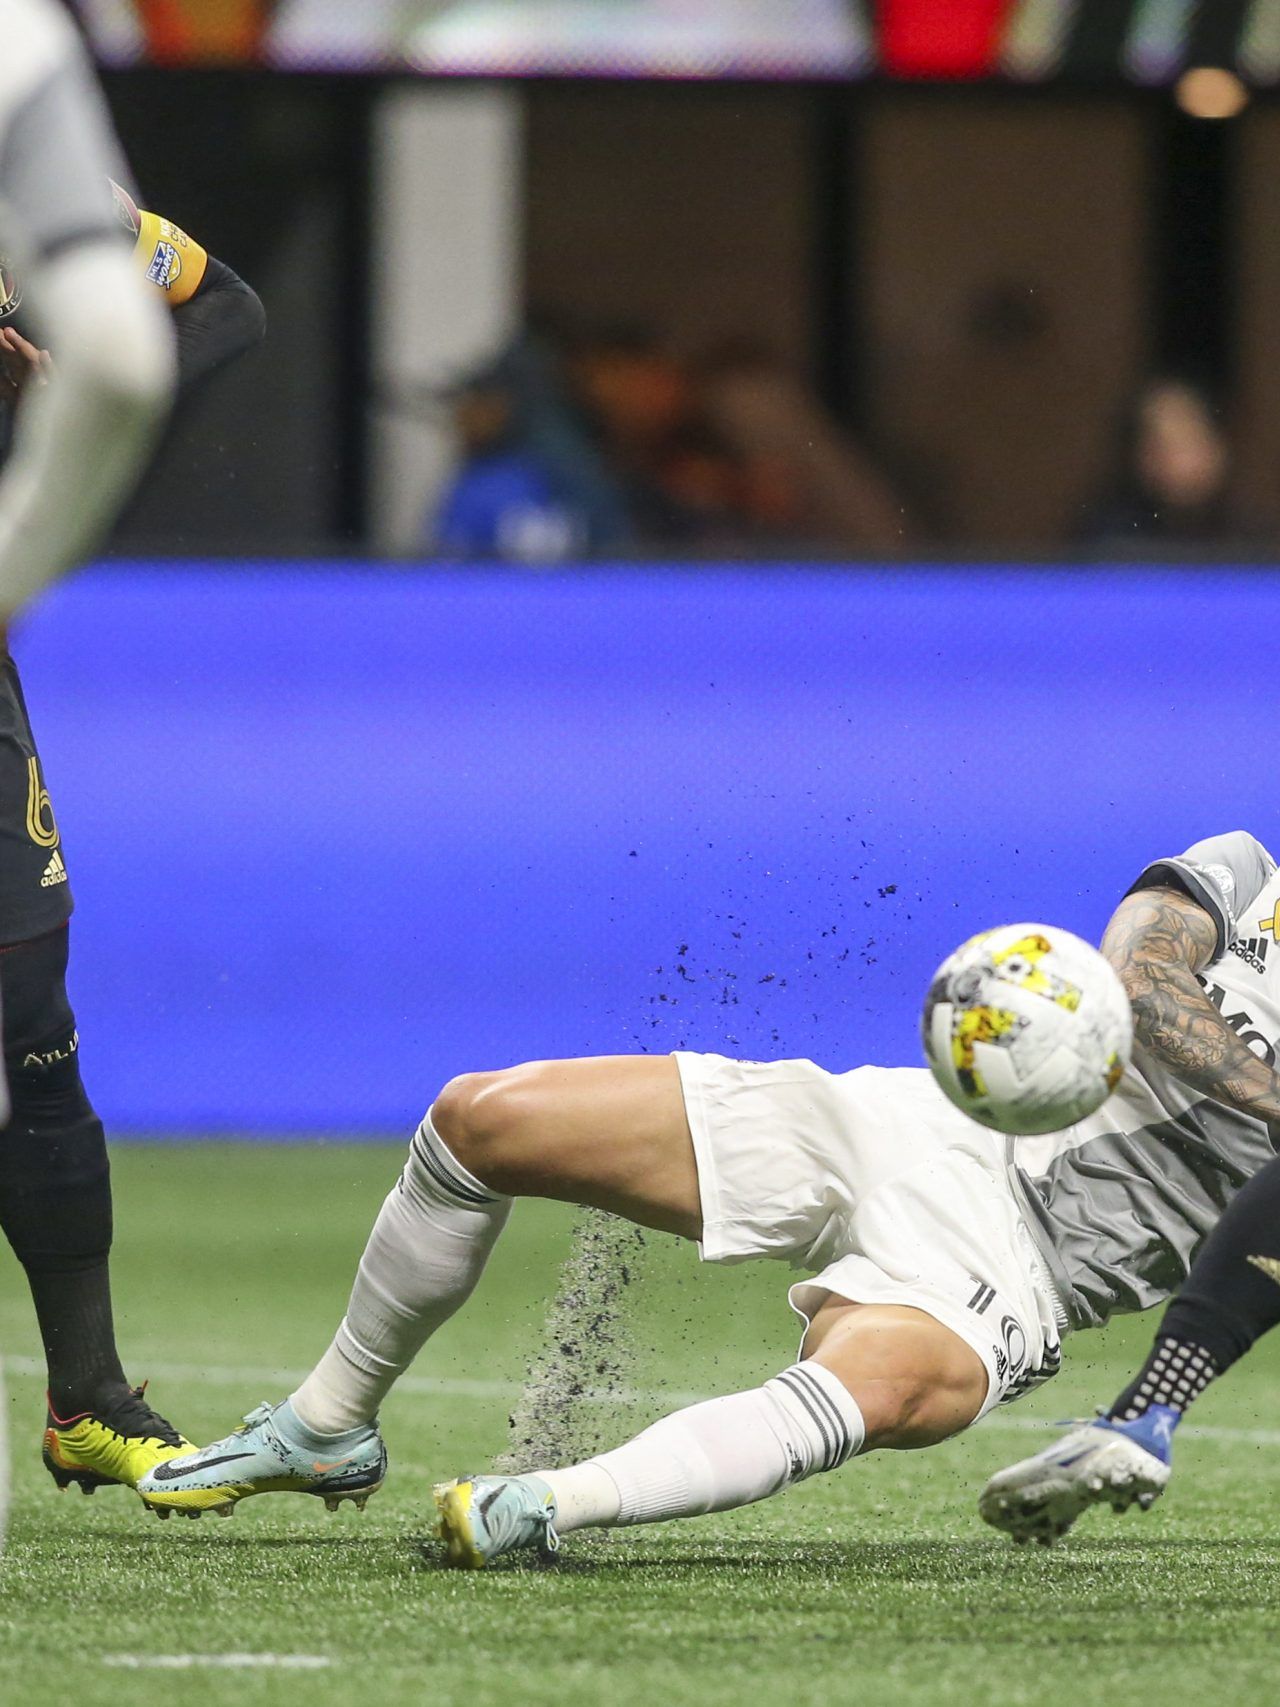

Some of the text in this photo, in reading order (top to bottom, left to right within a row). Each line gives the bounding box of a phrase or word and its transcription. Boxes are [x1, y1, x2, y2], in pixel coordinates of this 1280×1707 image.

[150, 256, 163, 278] MLS
[157, 245, 176, 287] WORKS
[1227, 941, 1267, 975] adidas
[966, 1276, 1026, 1382] 10
